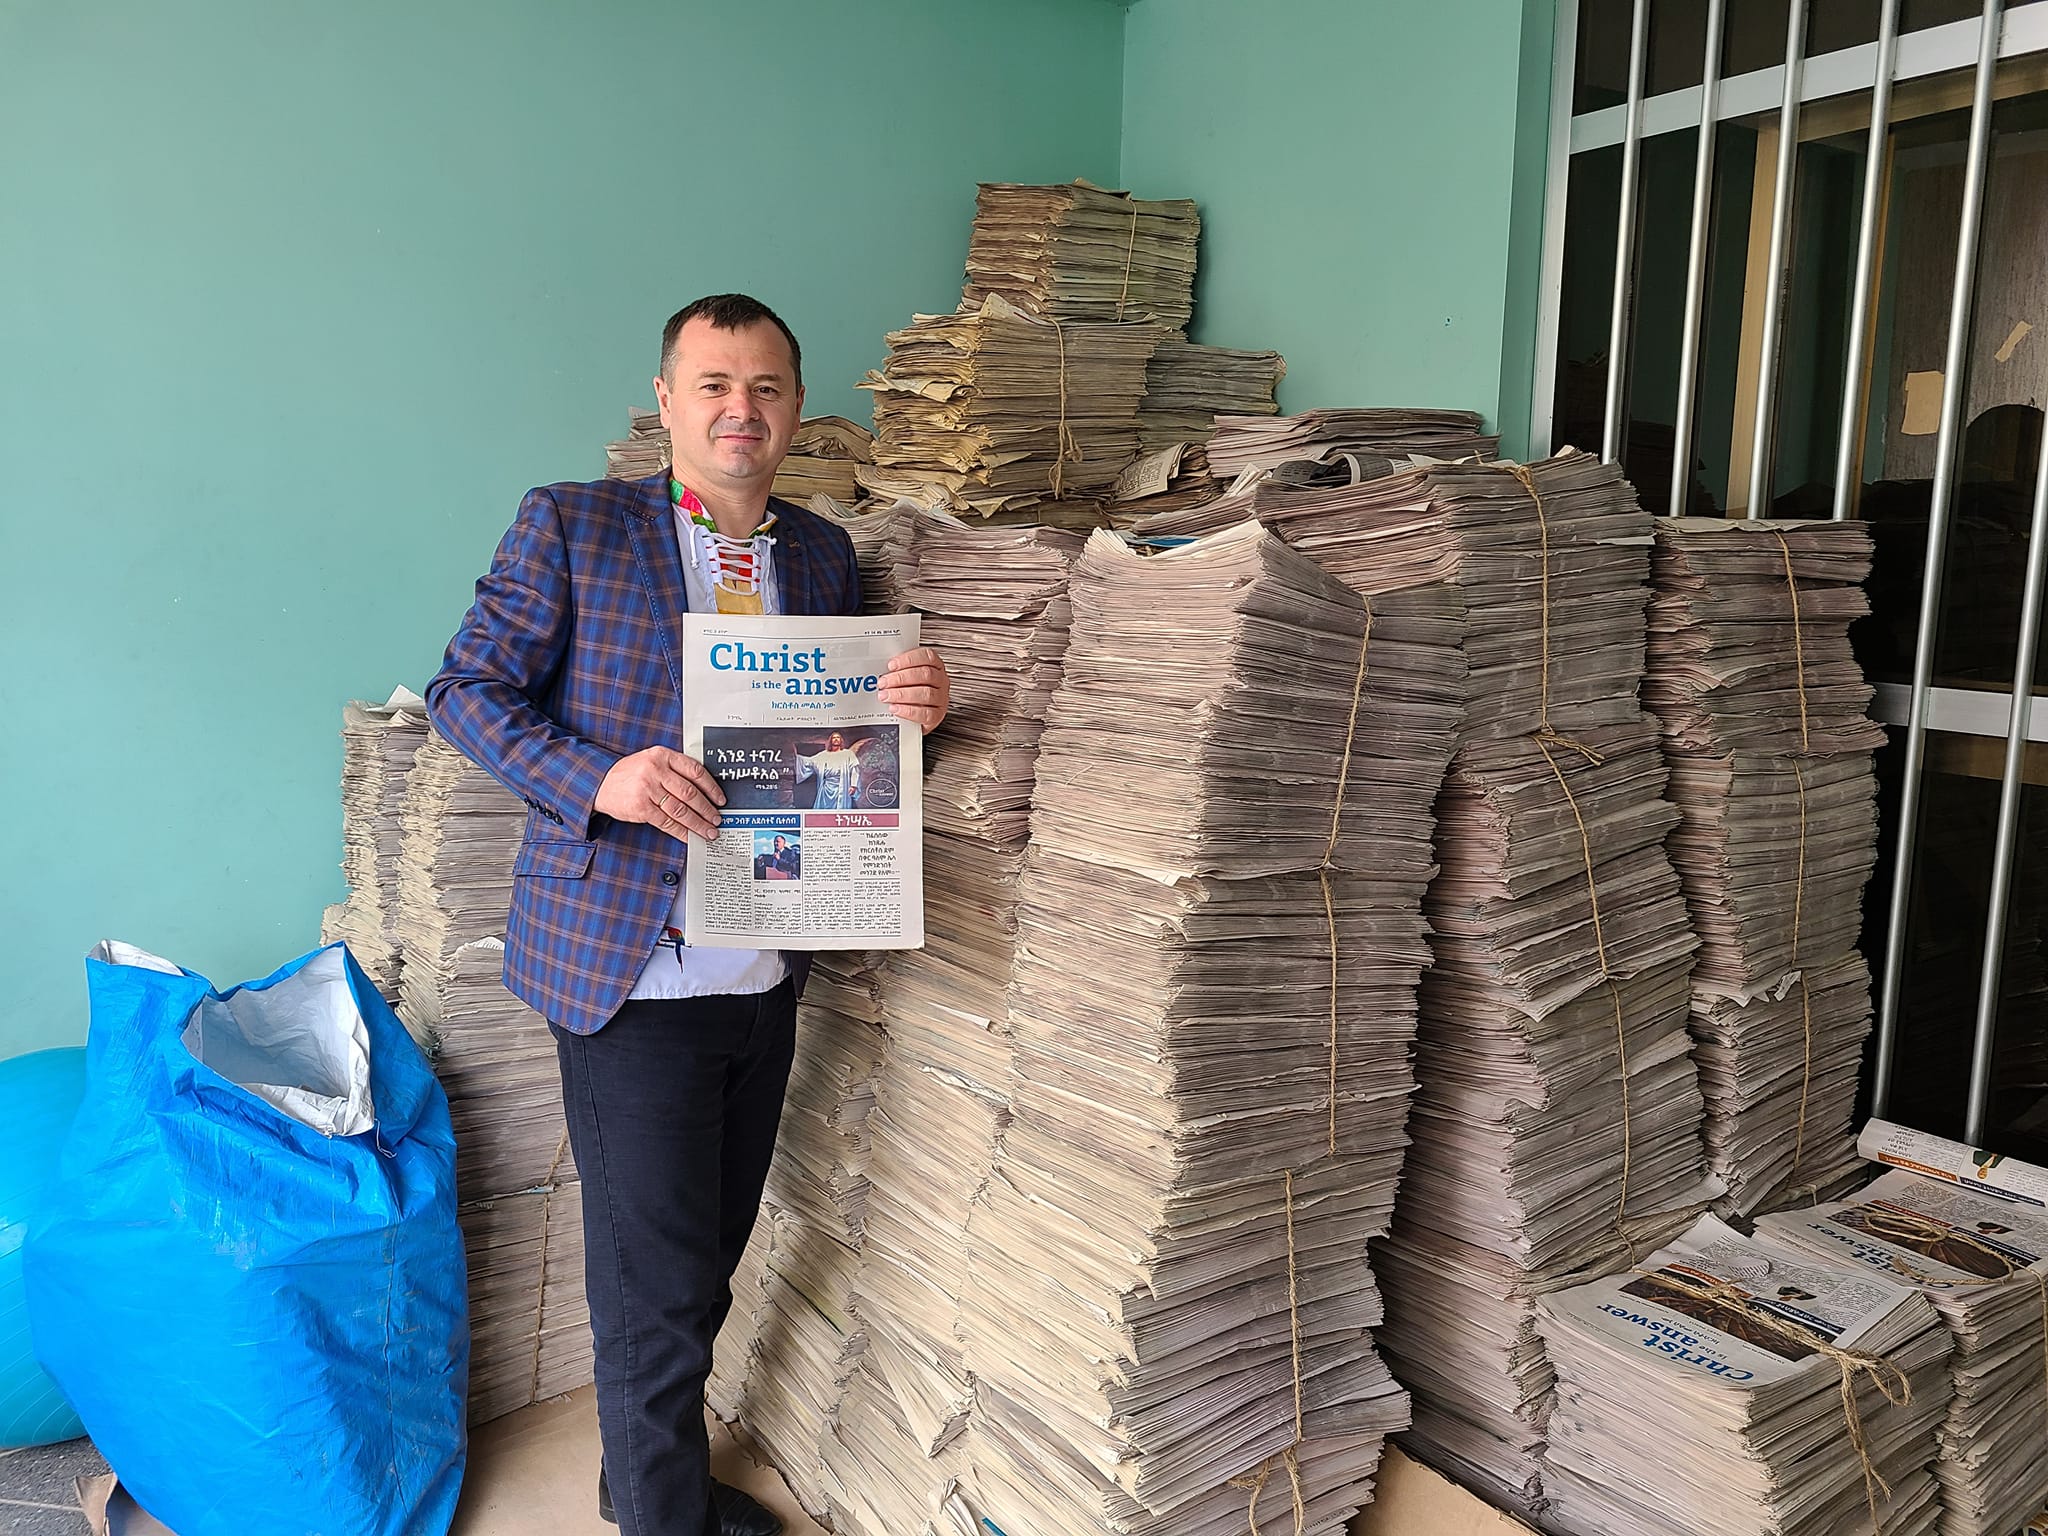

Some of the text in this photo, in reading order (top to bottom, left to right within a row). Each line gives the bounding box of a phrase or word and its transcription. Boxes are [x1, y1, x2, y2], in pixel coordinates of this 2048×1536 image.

[710, 642, 826, 673] Christ
[752, 675, 882, 696] is the answe
[717, 748, 746, 763] እንደ
[749, 749, 783, 763] ተናገረ
[835, 814, 873, 827] ትንሣኤ
[1806, 1222, 1896, 1262] nswer
[1596, 1303, 1699, 1347] answer
[1642, 1333, 1754, 1381] Christ
[1698, 1345, 1717, 1357] the
